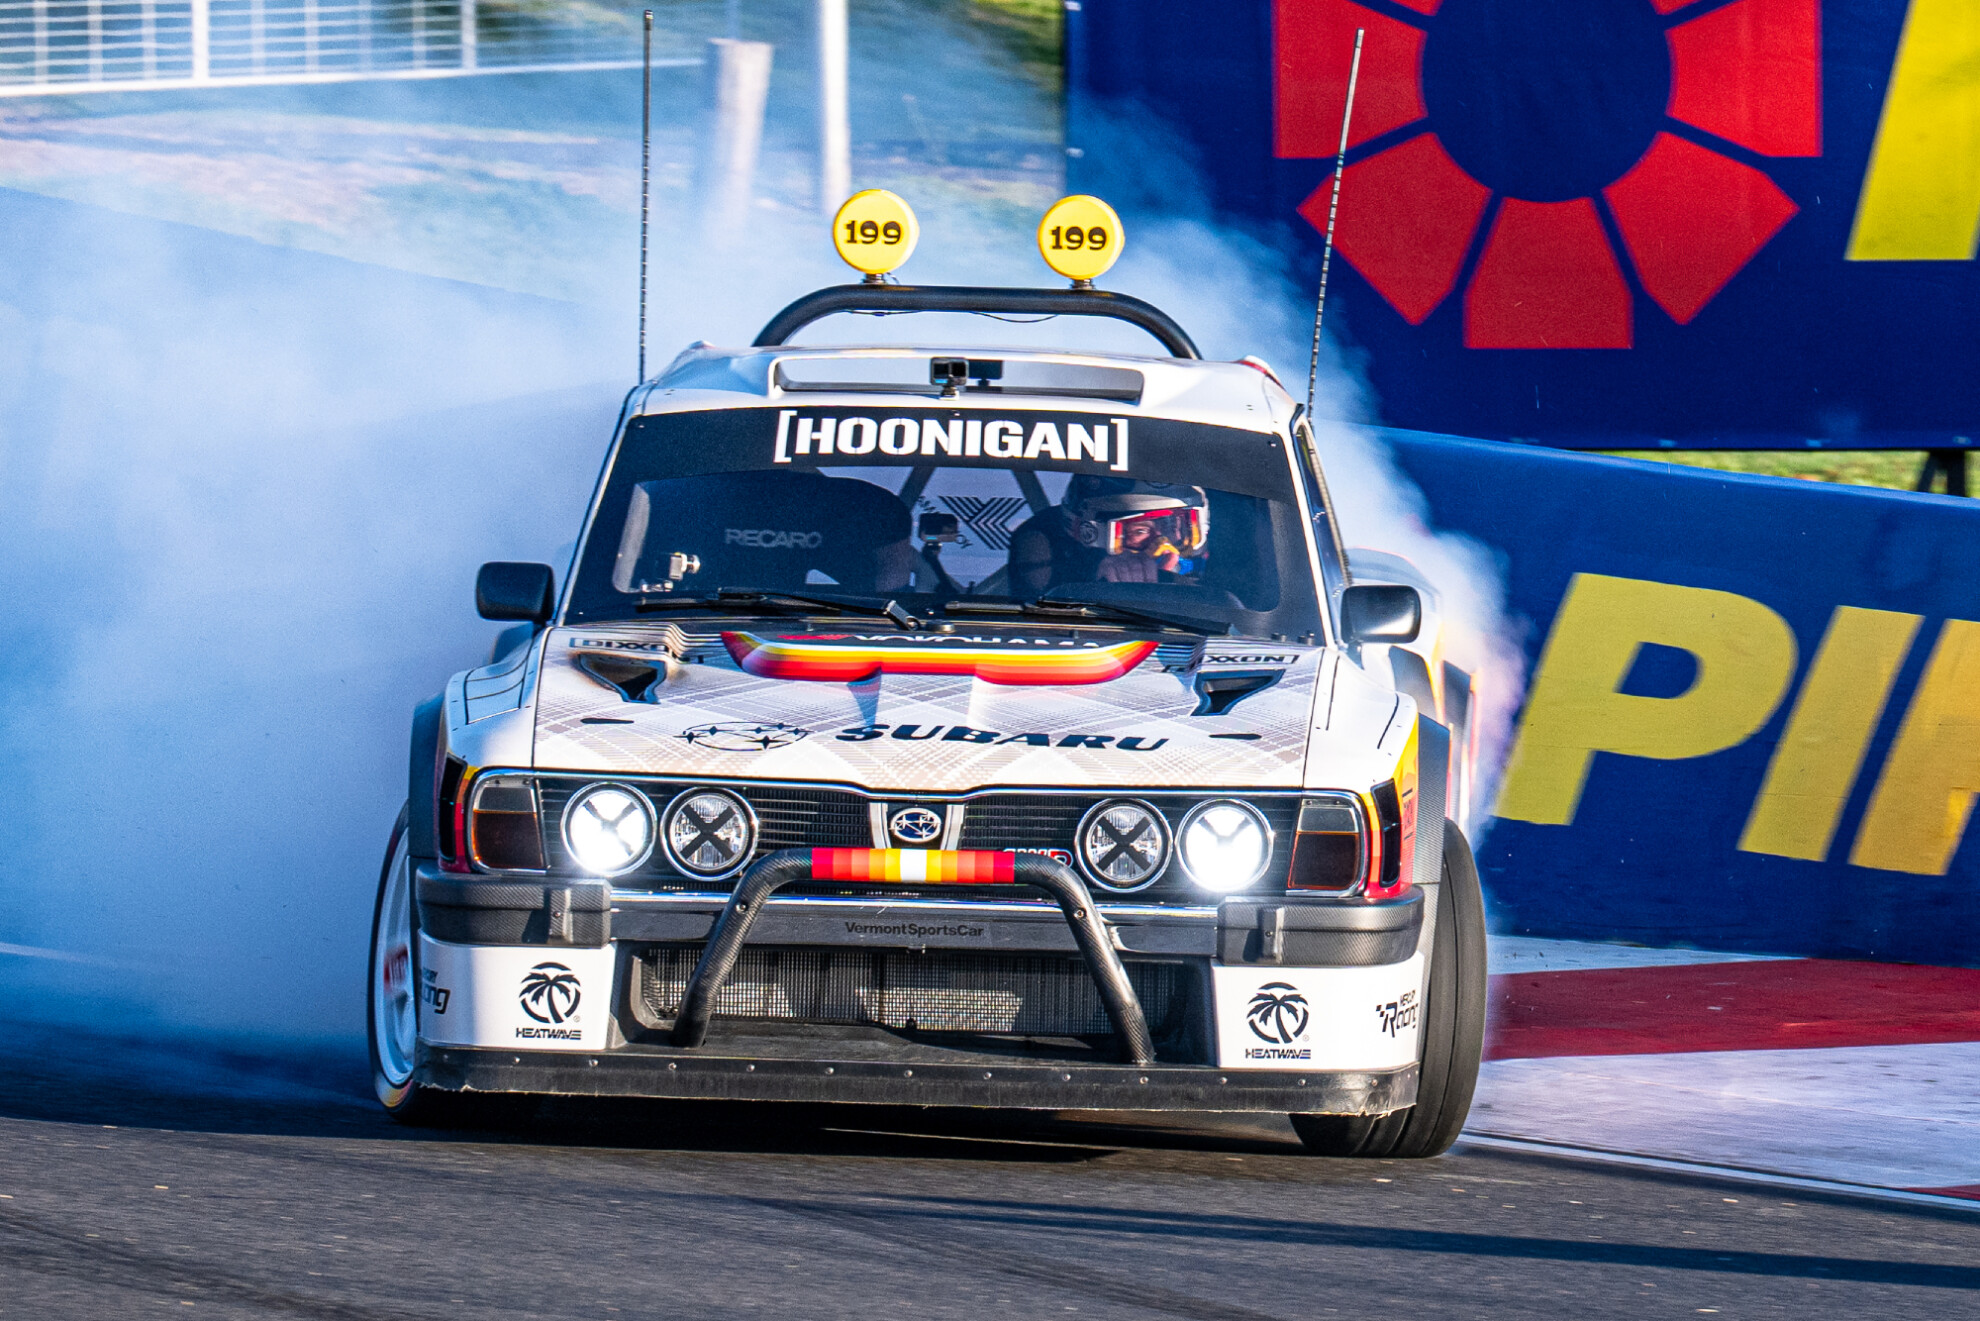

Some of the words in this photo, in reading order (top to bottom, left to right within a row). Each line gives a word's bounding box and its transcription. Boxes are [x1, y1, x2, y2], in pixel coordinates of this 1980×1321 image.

[845, 219, 902, 245] 199
[1050, 225, 1107, 251] 199
[724, 528, 823, 549] RECARO
[835, 723, 1170, 751] SUBARU
[845, 921, 985, 938] VermontSportsCar
[515, 1027, 582, 1041] HEATWAVE
[1245, 1047, 1312, 1060] HEATWAVE
